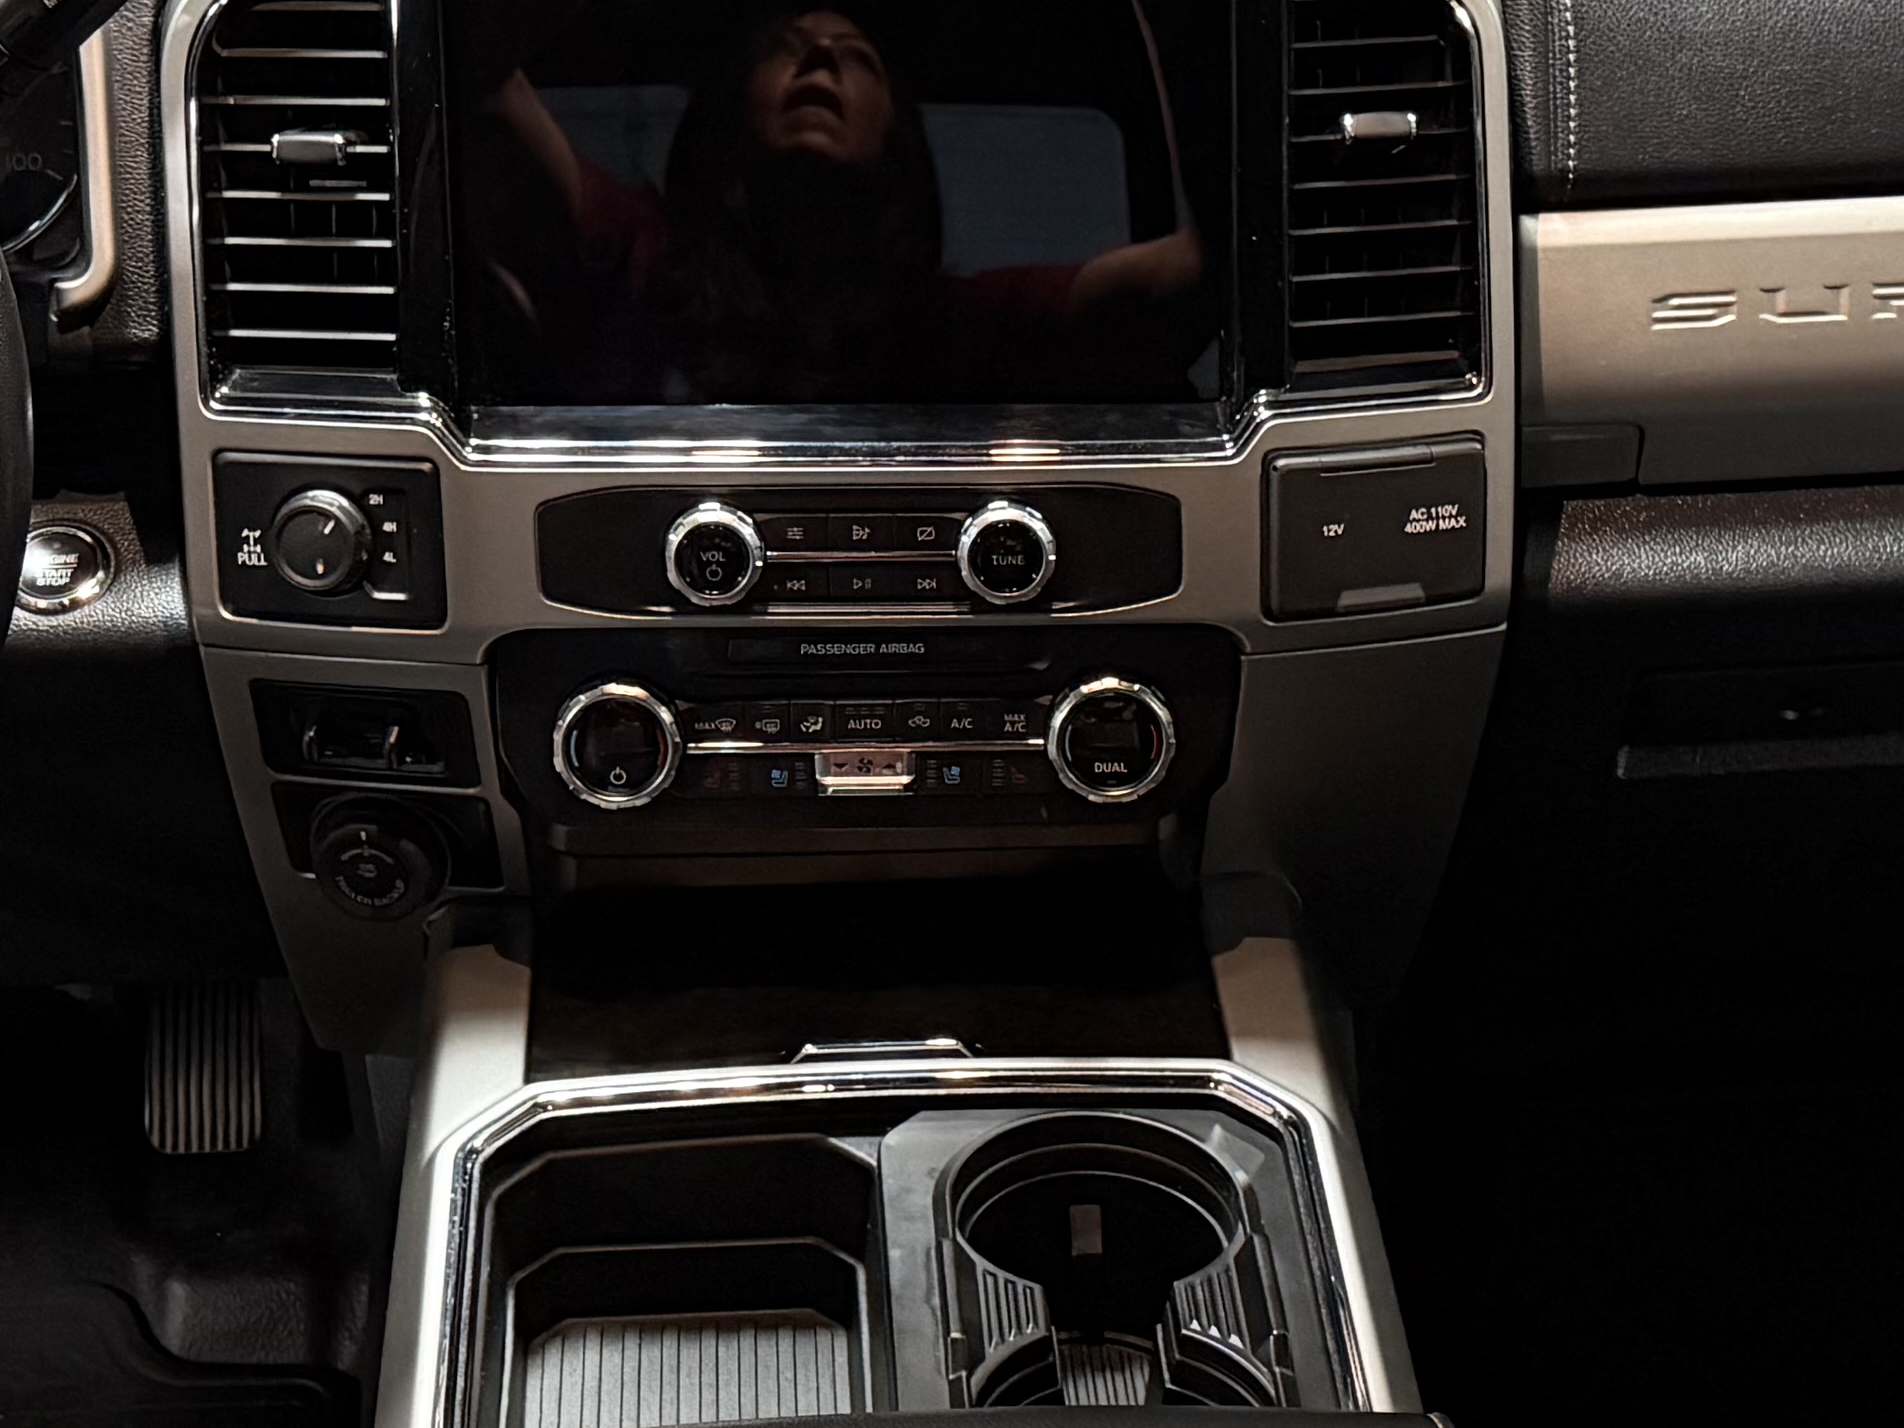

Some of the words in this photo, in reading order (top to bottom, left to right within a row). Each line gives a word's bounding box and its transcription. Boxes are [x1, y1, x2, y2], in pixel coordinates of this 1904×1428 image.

[369, 493, 384, 506] 2H
[1409, 507, 1428, 521] AC
[1431, 504, 1459, 518] 110V
[382, 521, 398, 534] 4H
[1322, 523, 1345, 537] 12V
[1404, 520, 1437, 535] 400W
[1439, 516, 1467, 531] MAX
[237, 552, 268, 566] PULL
[382, 551, 398, 564] 4L
[700, 550, 727, 563] VOL
[990, 554, 1026, 567] TUNE
[36, 577, 71, 586] STOP
[800, 642, 876, 655] PASSENGER
[879, 642, 925, 655] AIRBAG
[847, 718, 882, 730] AUTO
[950, 717, 974, 730] A/C
[1003, 713, 1027, 722] MAX
[1003, 721, 1027, 733] A/C
[1093, 761, 1128, 774] DUAL
